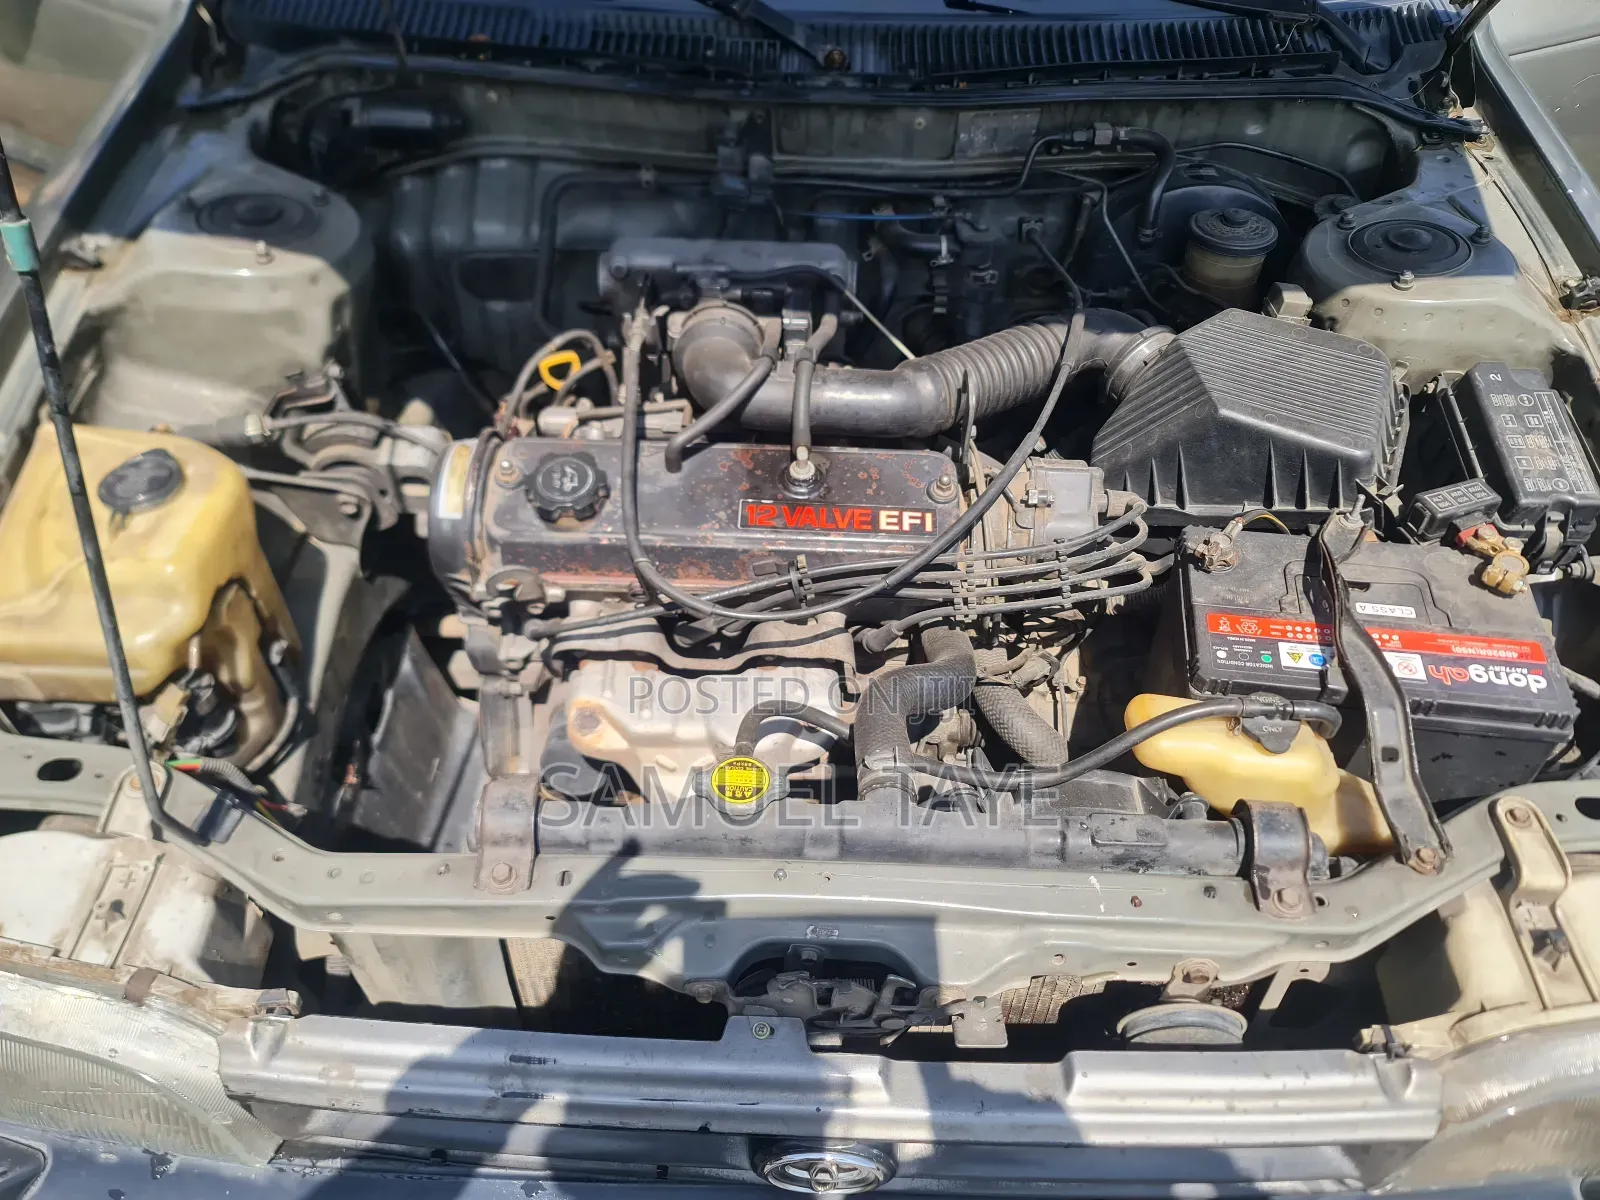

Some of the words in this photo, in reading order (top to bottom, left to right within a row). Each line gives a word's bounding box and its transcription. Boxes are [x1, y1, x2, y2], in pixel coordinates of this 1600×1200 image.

[745, 504, 777, 527] 12
[781, 505, 872, 530] VALVE
[878, 510, 933, 532] EFI
[1371, 605, 1413, 616] CLASS
[1216, 659, 1245, 667] CONDITION
[1488, 664, 1528, 675] BATTERY
[1428, 663, 1548, 694] dongah
